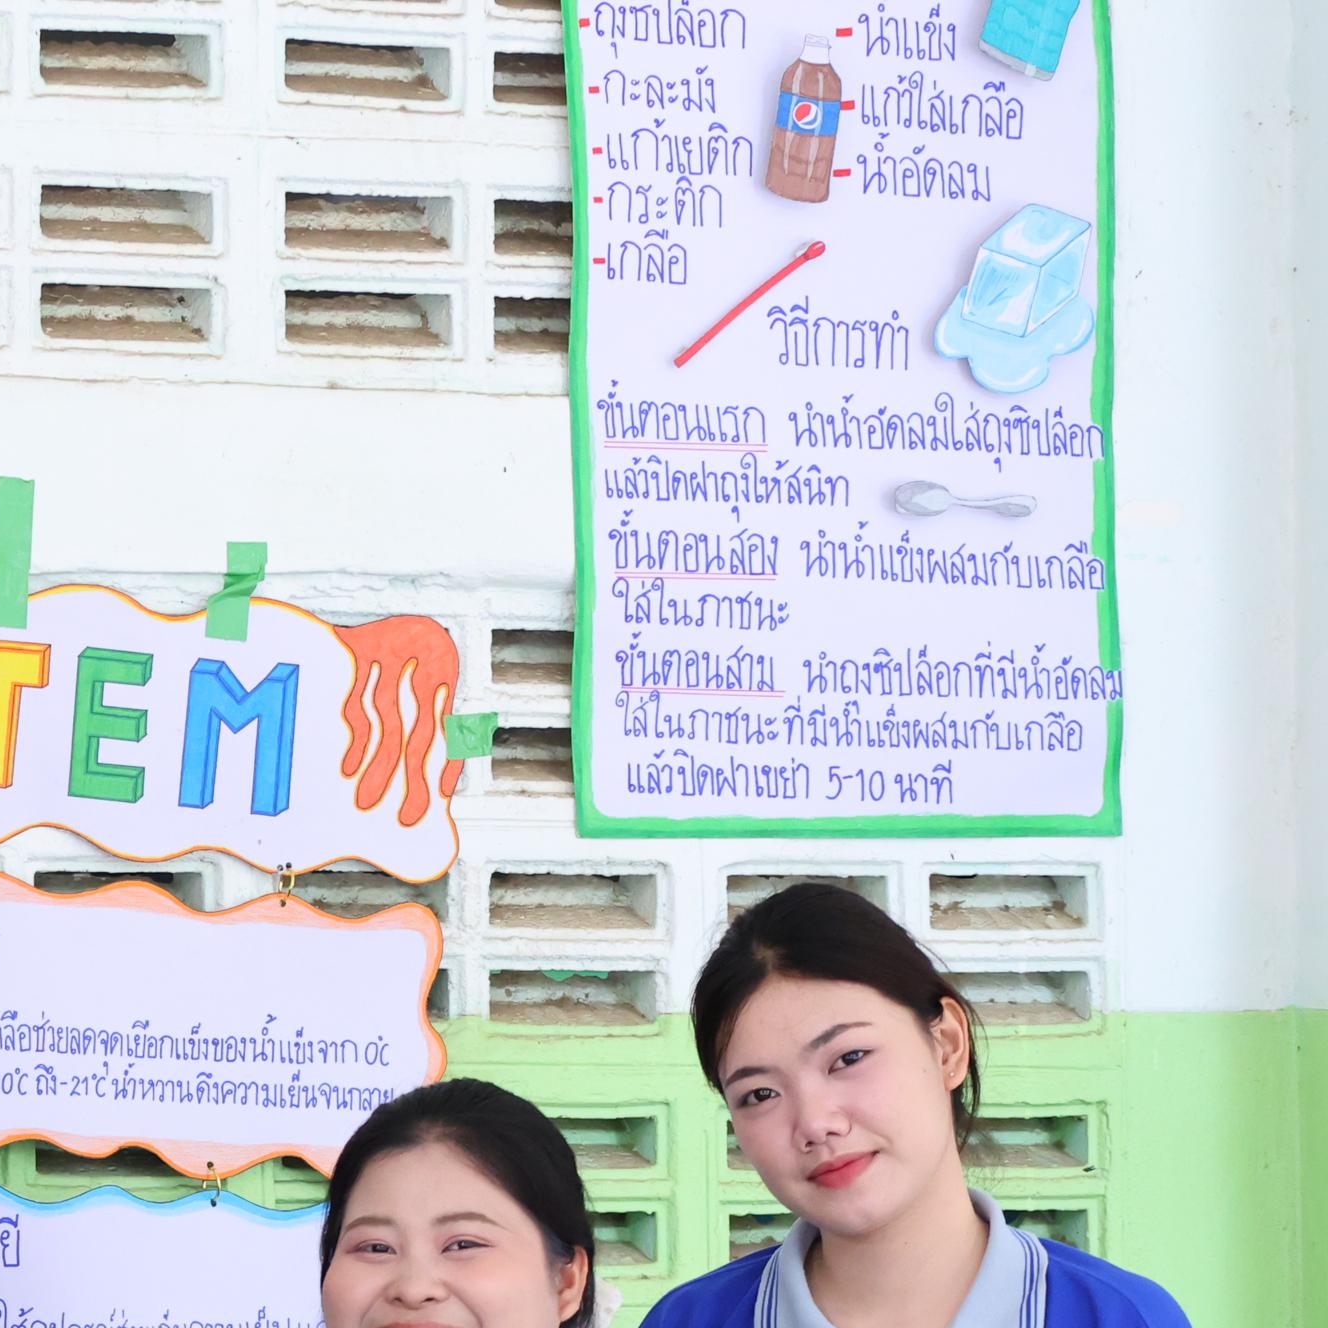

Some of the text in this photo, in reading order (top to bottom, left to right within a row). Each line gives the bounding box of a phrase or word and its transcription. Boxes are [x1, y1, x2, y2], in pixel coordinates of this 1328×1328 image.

[603, 65, 716, 113] กะละมัง
[861, 70, 1024, 140] แก้วใส่เกลือ
[856, 132, 991, 202] น้ำอัดลม
[607, 175, 722, 228] กระติก
[607, 229, 687, 285] เกลือ
[767, 296, 910, 371] วิธีการทำ
[596, 379, 767, 444] ขั้นตอนแรก
[607, 509, 778, 576] ขั้นตอนสอง
[611, 576, 790, 632] ใส่ในภาชนะ
[615, 631, 775, 692] ขั้นตอนสาม
[825, 765, 885, 802] 5-10
[894, 760, 954, 804] นาที
